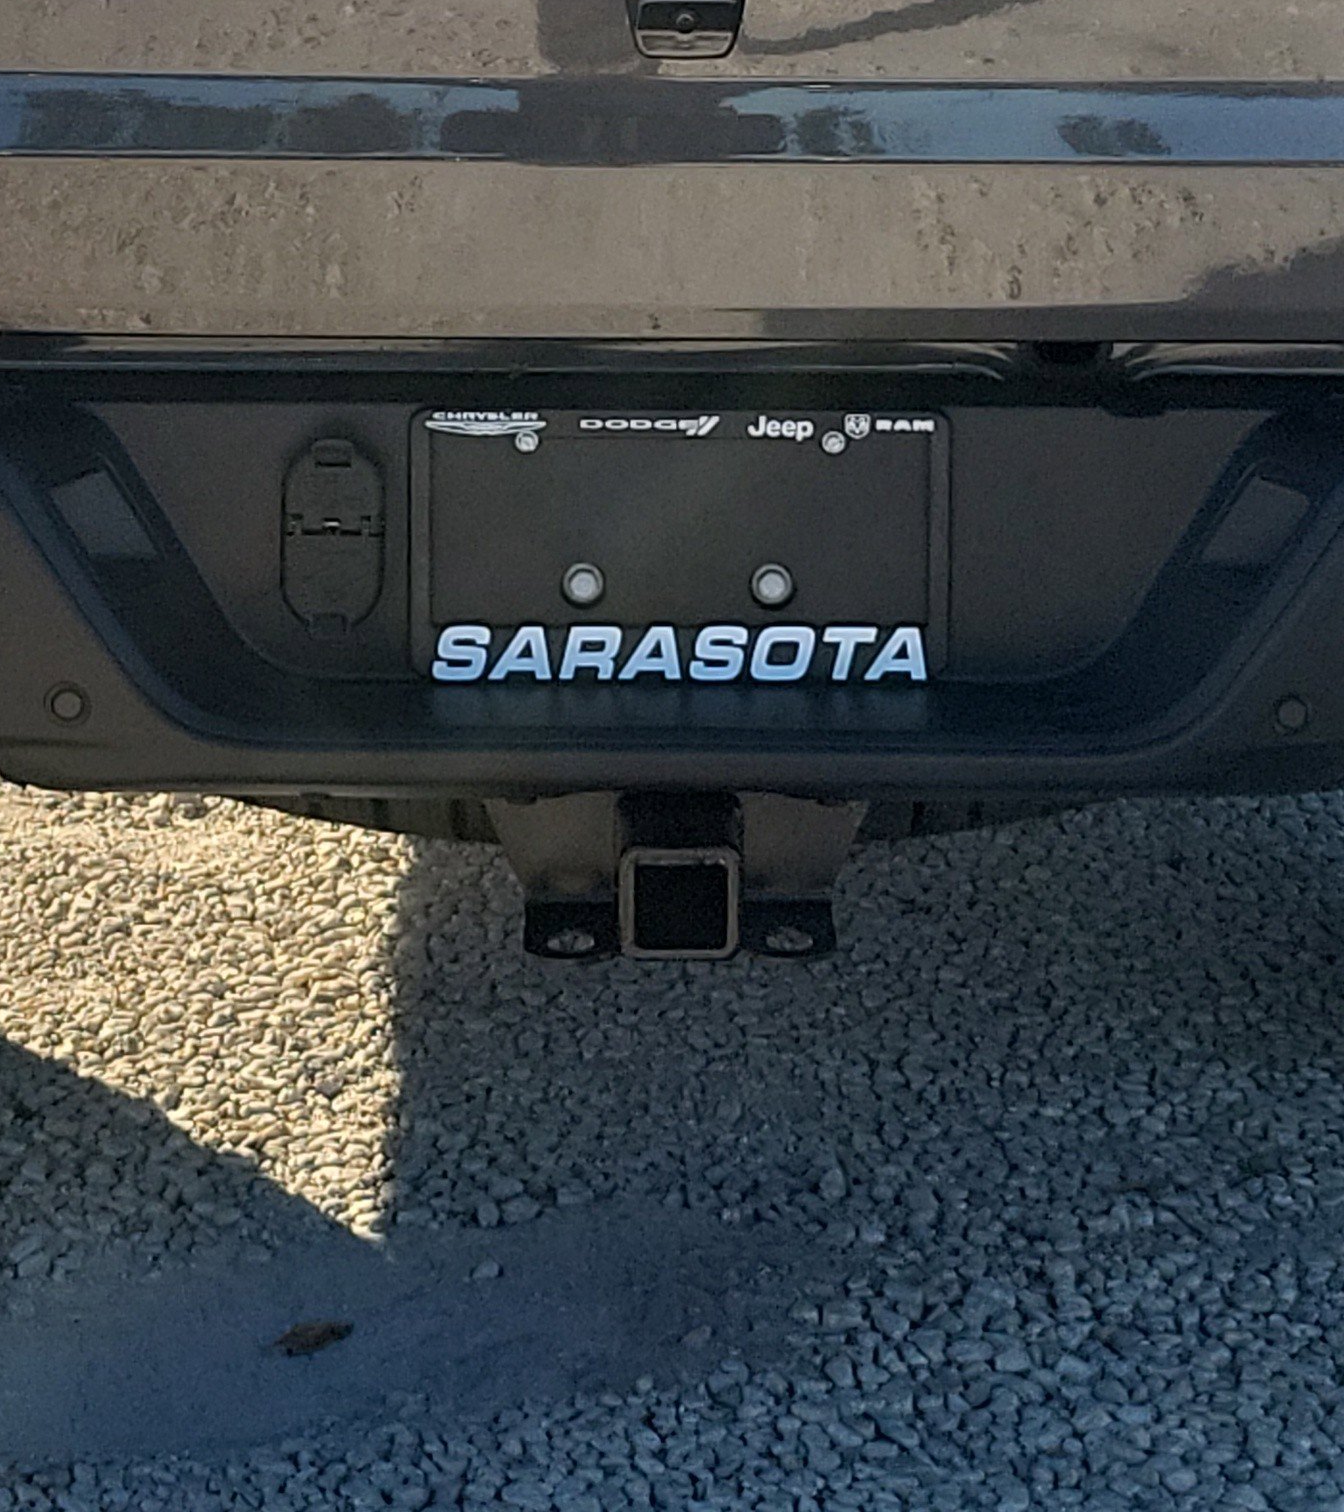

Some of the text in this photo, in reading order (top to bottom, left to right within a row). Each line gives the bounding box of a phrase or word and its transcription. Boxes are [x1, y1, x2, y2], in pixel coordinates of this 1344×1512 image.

[432, 411, 935, 442] CHRYSLER DODGE Jeep RAM
[432, 625, 927, 681] SARASOTA
